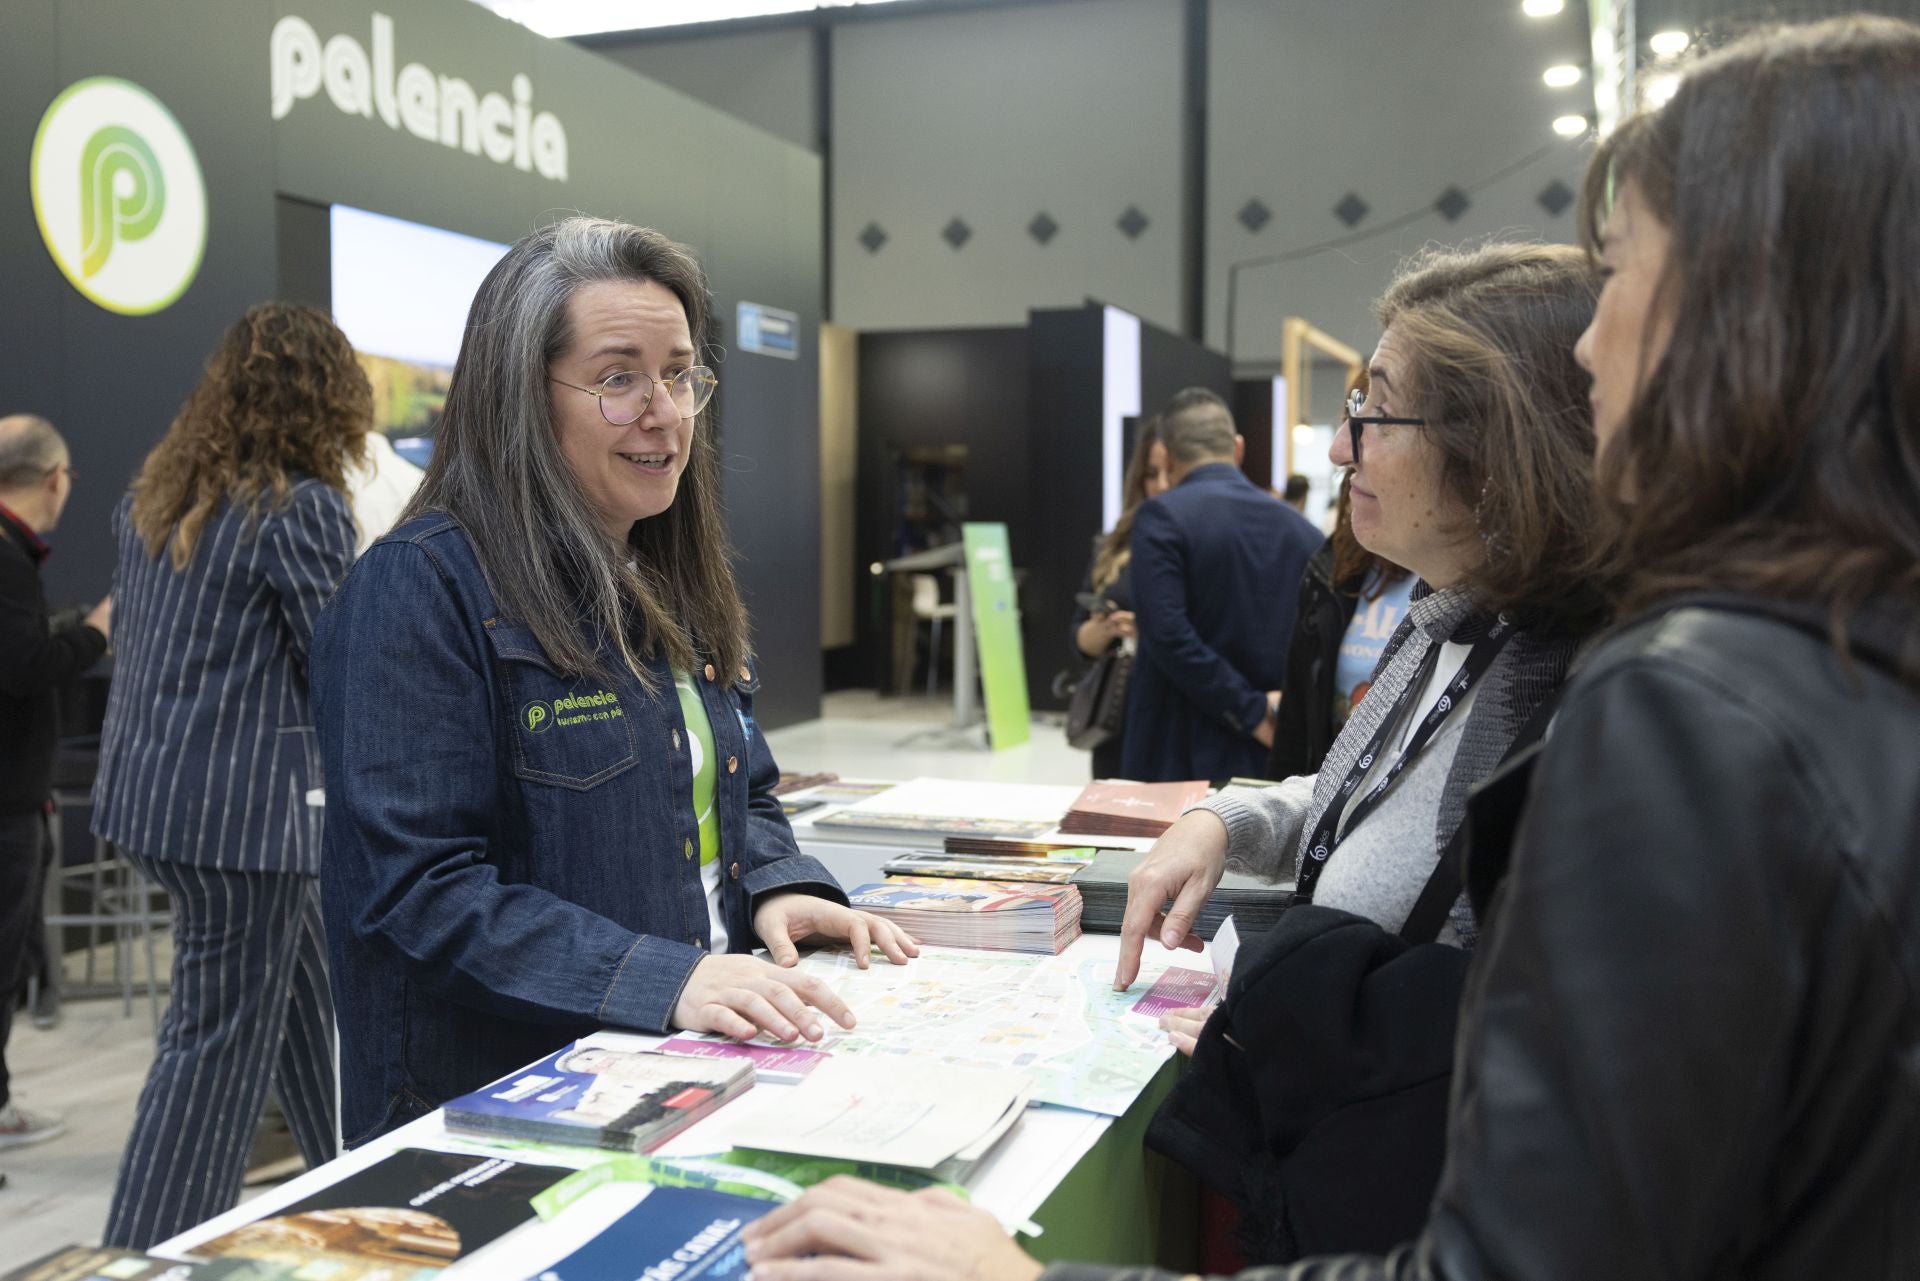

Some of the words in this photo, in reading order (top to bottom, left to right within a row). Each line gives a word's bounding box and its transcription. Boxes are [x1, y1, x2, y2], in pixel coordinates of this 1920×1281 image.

[270, 11, 568, 182] palencia
[554, 690, 618, 715] palencia
[557, 714, 592, 727] turismo
[593, 711, 609, 720] con
